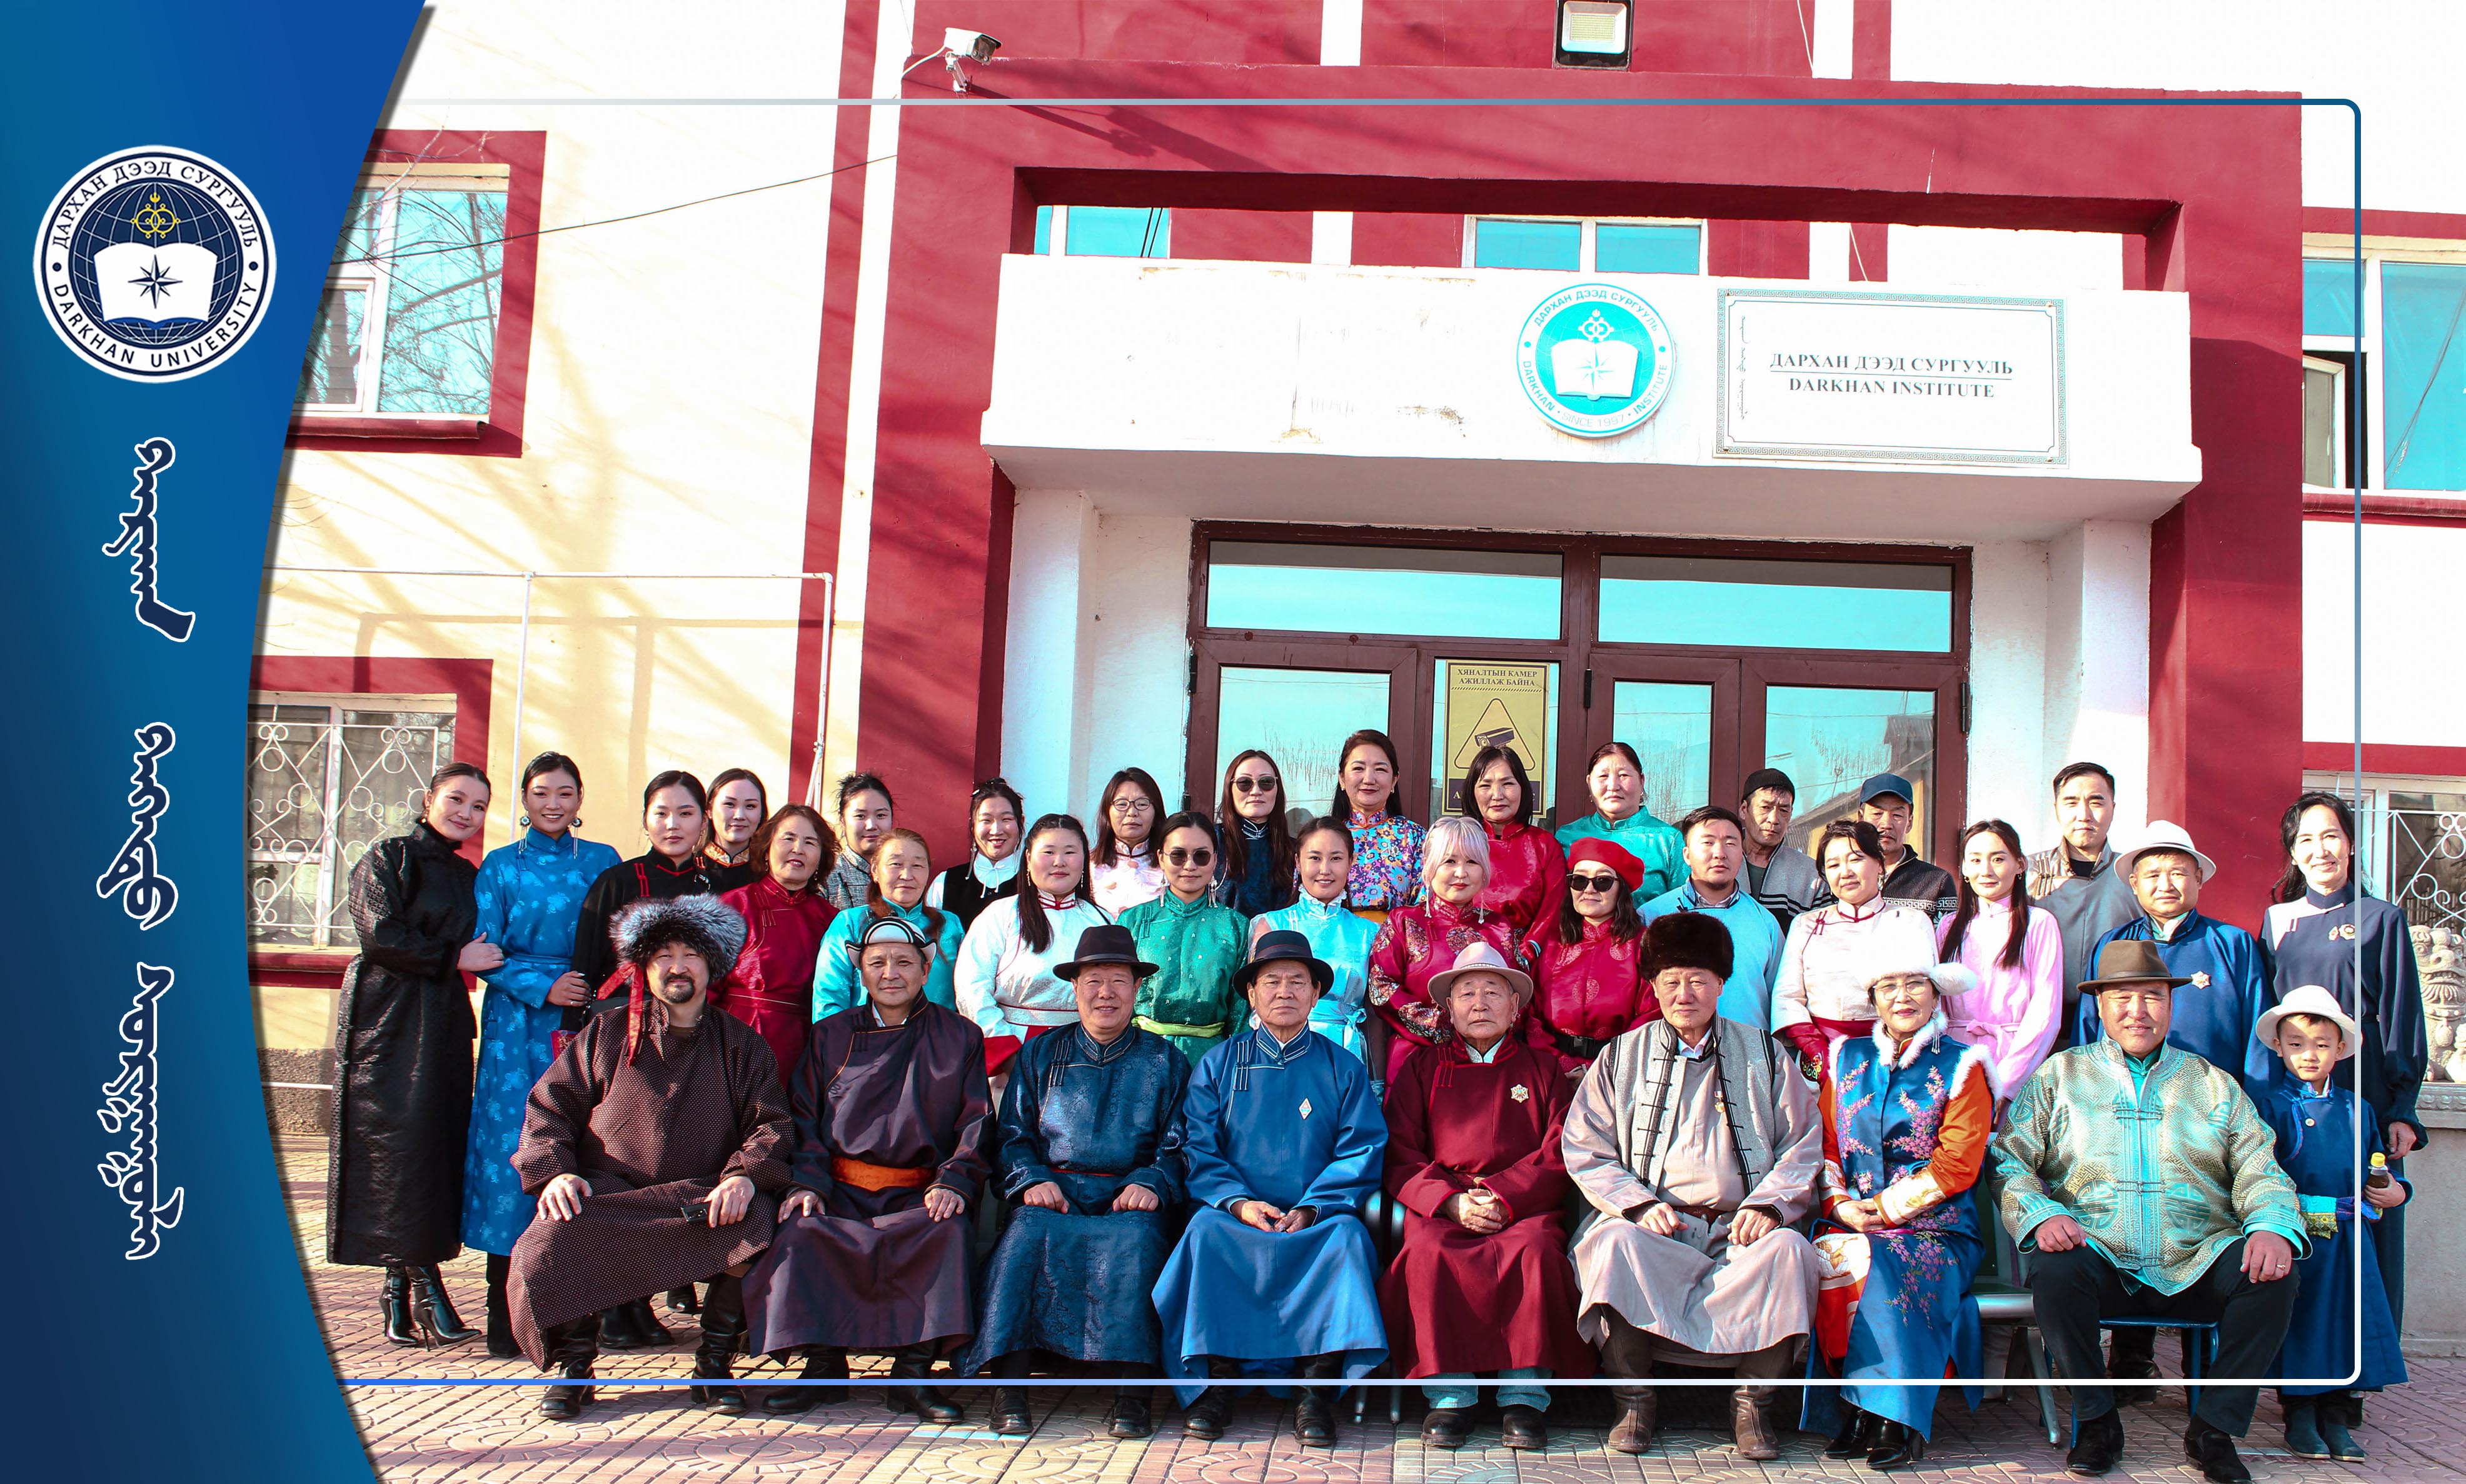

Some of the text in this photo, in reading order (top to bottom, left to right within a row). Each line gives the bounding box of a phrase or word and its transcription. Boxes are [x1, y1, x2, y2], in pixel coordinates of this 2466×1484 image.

[1534, 289, 1658, 332] ДАРХАН ДЭЭД СУРГУУЛЬ
[1770, 353, 2013, 374] ДАРХАН ДЭЭД СУРГУУЛЬ
[1523, 361, 1668, 428] DARKHAN SINCE 1997 INSTITUTE
[1789, 378, 1995, 398] DARKHAN INSTITUTE
[1506, 678, 1535, 686] БАЙНА
